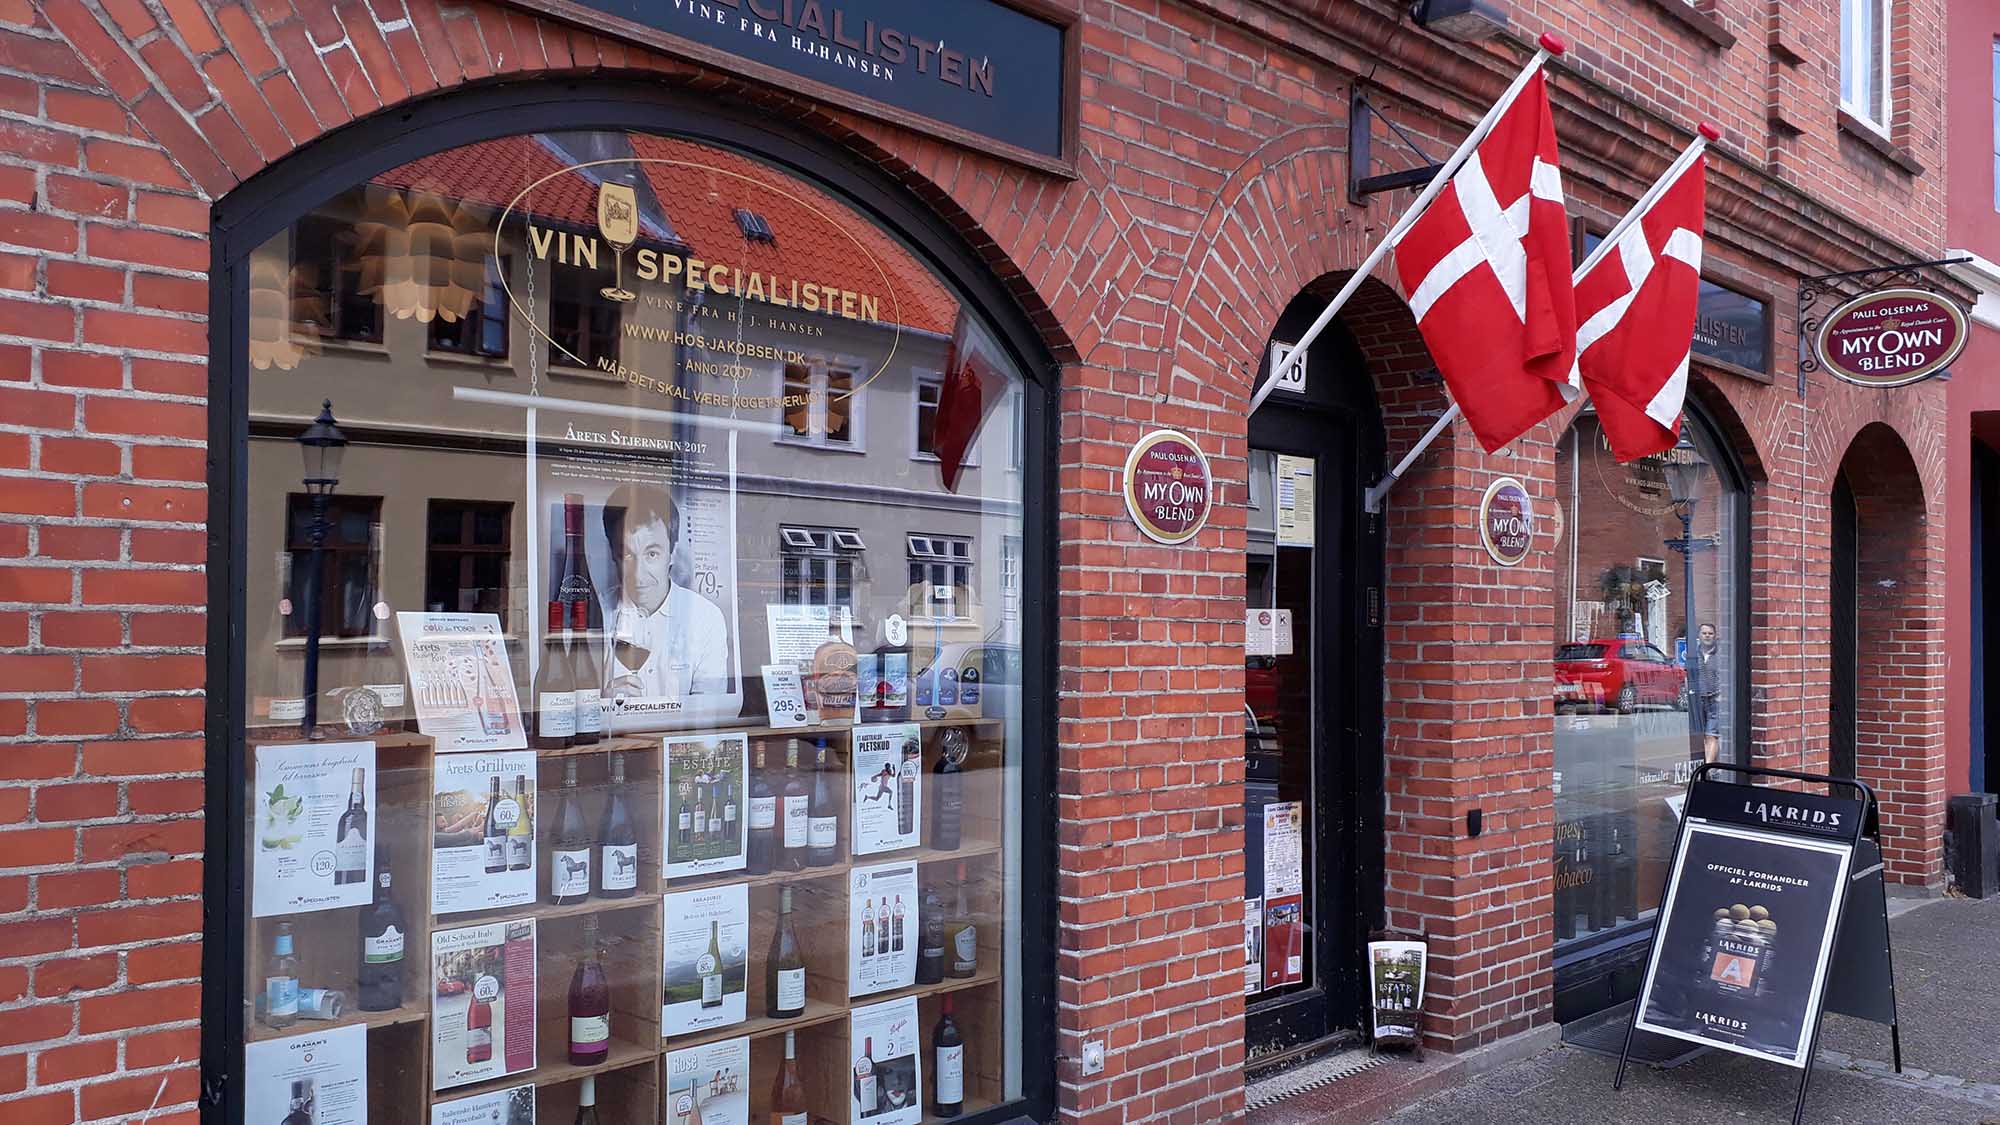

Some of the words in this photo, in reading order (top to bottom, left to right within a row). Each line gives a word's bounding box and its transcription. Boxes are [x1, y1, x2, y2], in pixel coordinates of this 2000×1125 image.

[740, 18, 777, 42] FRA
[791, 35, 895, 81] H.J.HANSEN
[529, 225, 598, 270] VIN
[636, 248, 879, 322] SPECIALISTEN
[645, 295, 684, 313] VINE
[692, 305, 720, 319] FRA
[769, 319, 824, 337] HANSEN
[1852, 308, 1878, 320] PAUL
[1879, 304, 1914, 317] OLSEN
[625, 322, 806, 365] WWW.HOS-JAKOBSEN.DK
[1842, 335, 1875, 355] MY
[1877, 328, 1942, 354] OWN
[685, 359, 719, 376] ANNO
[722, 364, 753, 380] 2007
[1858, 352, 1925, 371] BLEND
[597, 355, 627, 378] NÅR
[629, 371, 655, 390] DET
[657, 383, 691, 401] SKAL
[694, 391, 729, 408] VÆRE
[564, 422, 607, 443] ÅRETS
[611, 430, 682, 453] STJERNEVIN
[685, 442, 707, 454] 2017
[1150, 451, 1168, 460] PAUL
[1168, 453, 1188, 463] OLSEN
[1144, 482, 1167, 500] MY
[1169, 481, 1203, 505] OWN
[1155, 505, 1195, 522] BLEND
[1493, 518, 1509, 532] MY
[1500, 535, 1525, 548] BLEND
[600, 705, 615, 713] VIN
[623, 702, 682, 712] SPECIALISTEN
[774, 699, 802, 712] 295,-
[858, 740, 890, 753] PLETSKUD
[446, 761, 473, 775] Årets
[683, 756, 731, 770] ESTATE
[1743, 801, 1842, 826] LAKRIDS
[1707, 863, 1747, 876] OFFICIEL
[1748, 870, 1809, 887] FORHANDLER
[1730, 877, 1742, 885] AF
[1744, 879, 1783, 892] LAKRIDS
[1719, 939, 1760, 954] LAKRIDS
[1721, 958, 1742, 981] A
[1379, 983, 1412, 992] ESTATE
[1695, 1011, 1749, 1030] LAKRIDS
[673, 1053, 698, 1074] Rosé
